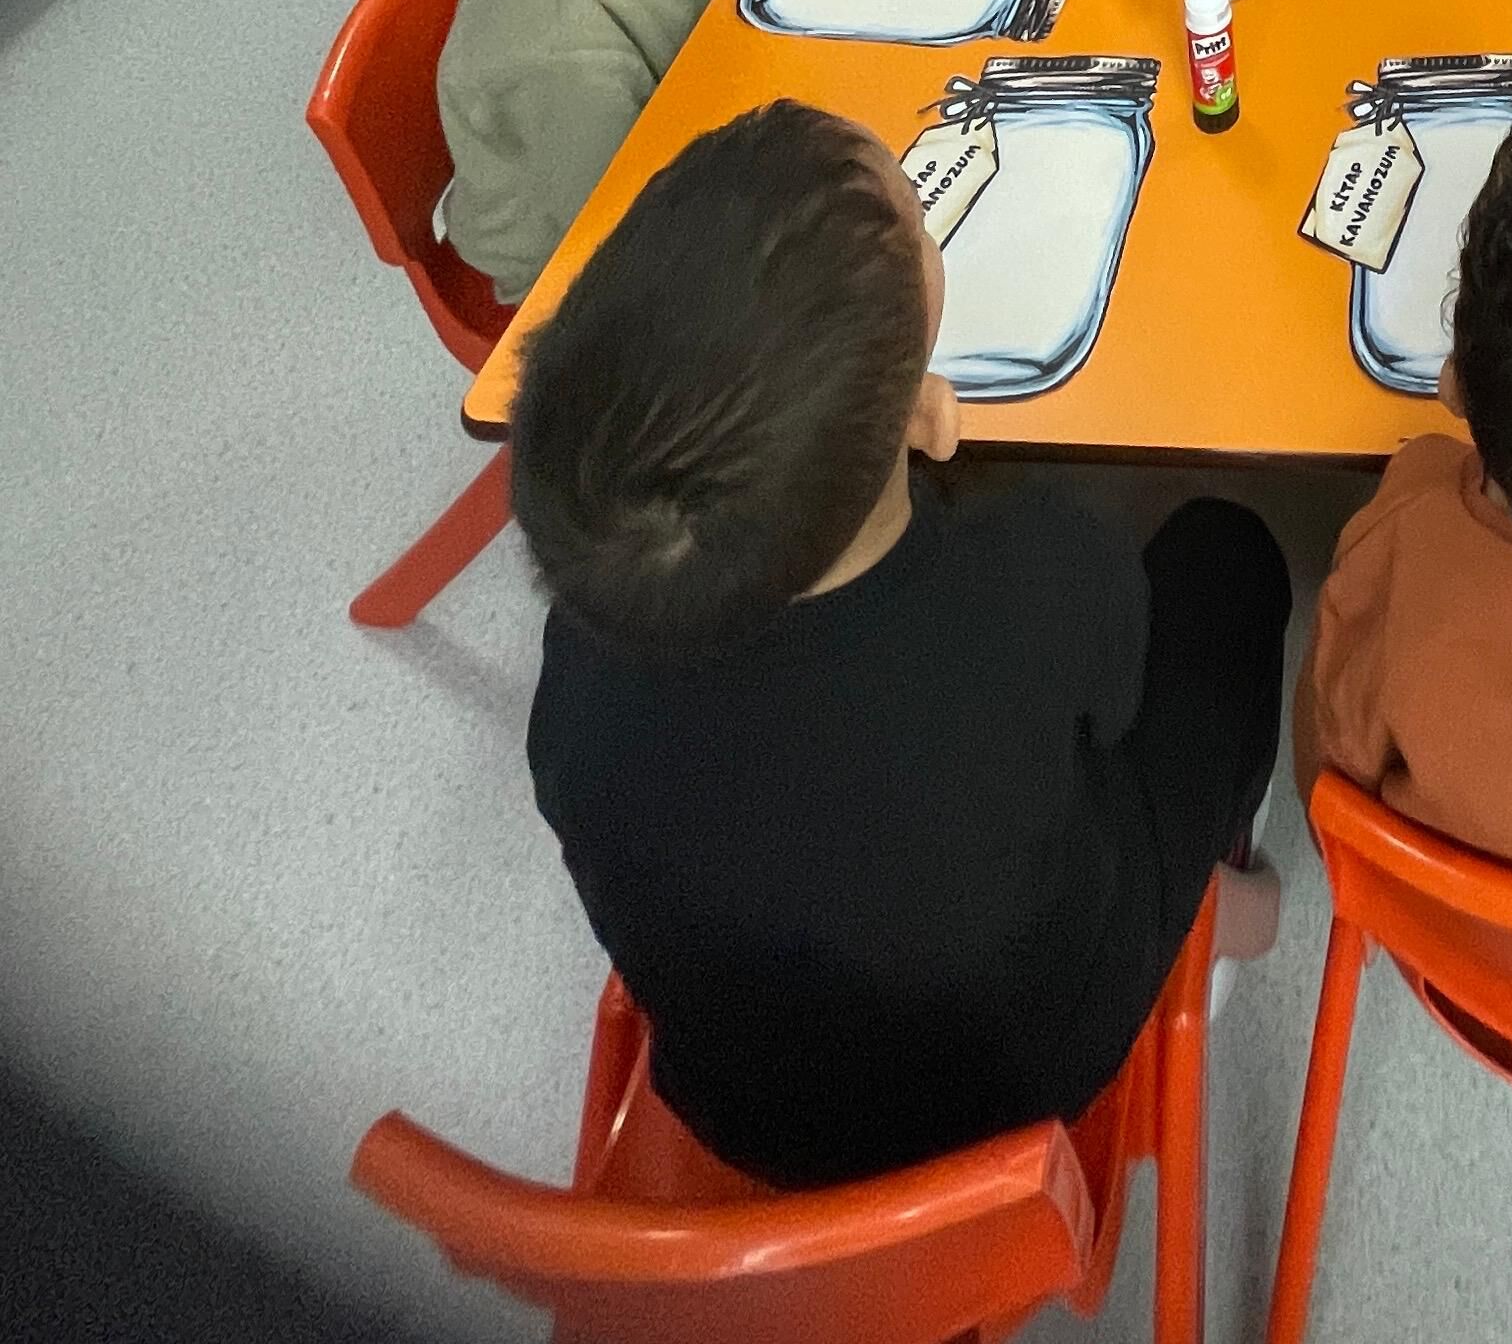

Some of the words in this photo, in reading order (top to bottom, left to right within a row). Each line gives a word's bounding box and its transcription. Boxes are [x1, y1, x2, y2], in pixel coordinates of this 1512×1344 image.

[921, 145, 982, 212] ANOZUM
[1329, 162, 1363, 212] KİTAP
[1339, 145, 1401, 247] KAVANOZUM
